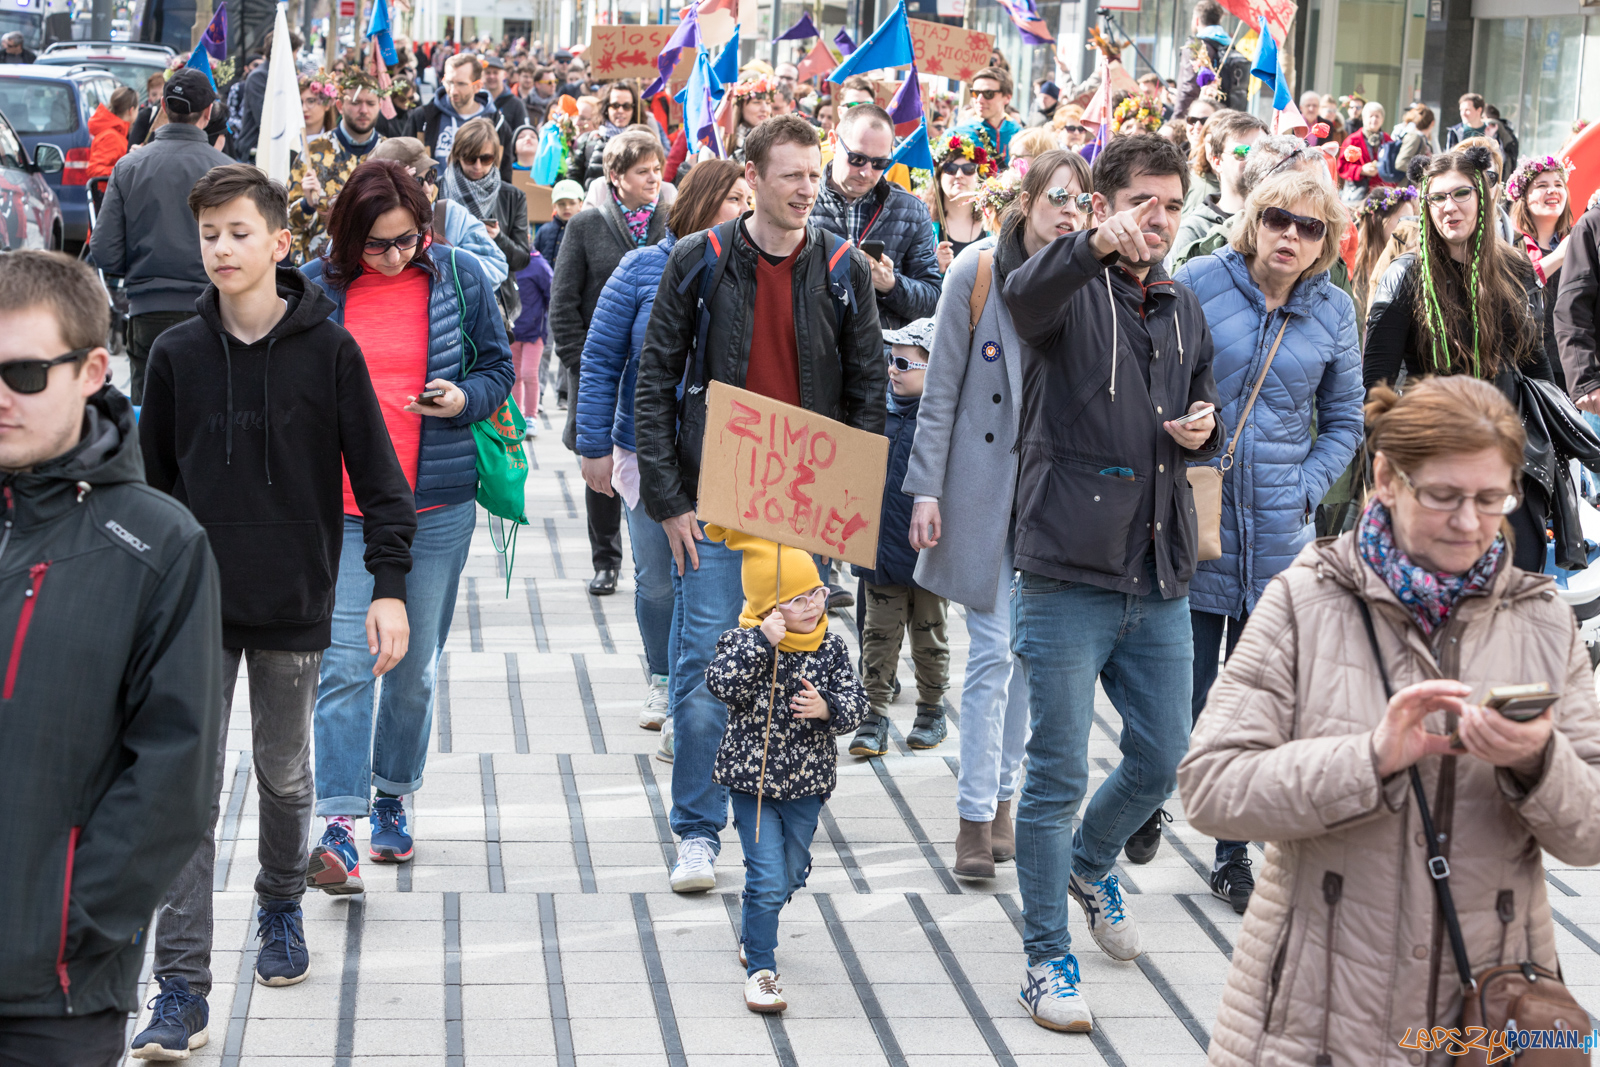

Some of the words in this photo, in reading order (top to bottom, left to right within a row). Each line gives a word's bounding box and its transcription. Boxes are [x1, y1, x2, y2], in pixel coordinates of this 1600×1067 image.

[908, 20, 951, 41] ITAJ
[937, 44, 988, 66] WIOSNO
[725, 400, 837, 470] ZIMO
